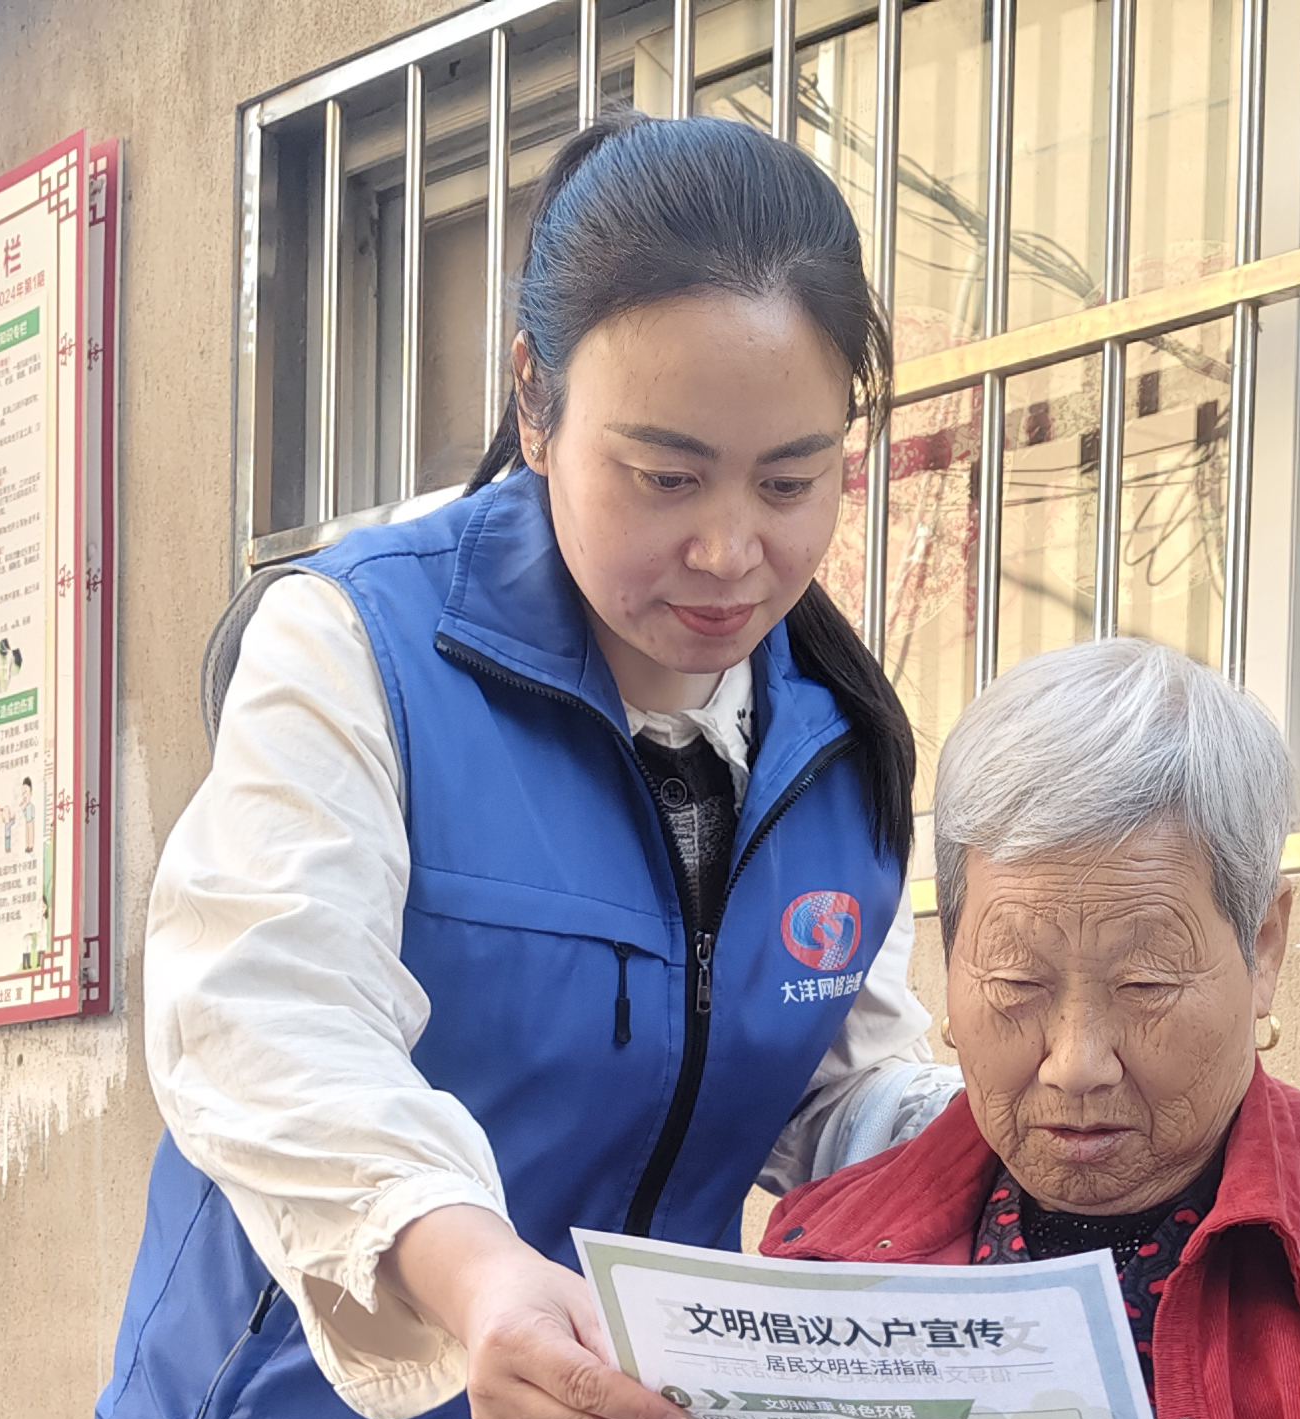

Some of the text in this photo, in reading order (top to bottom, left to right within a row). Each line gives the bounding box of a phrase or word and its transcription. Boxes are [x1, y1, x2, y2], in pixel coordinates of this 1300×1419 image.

[15, 986, 23, 1001] 宣
[683, 1302, 1004, 1348] 文明倡议入户宣传
[766, 1355, 938, 1377] 居民文明生活指南
[761, 1398, 916, 1419] 文明健康 绿色环保
